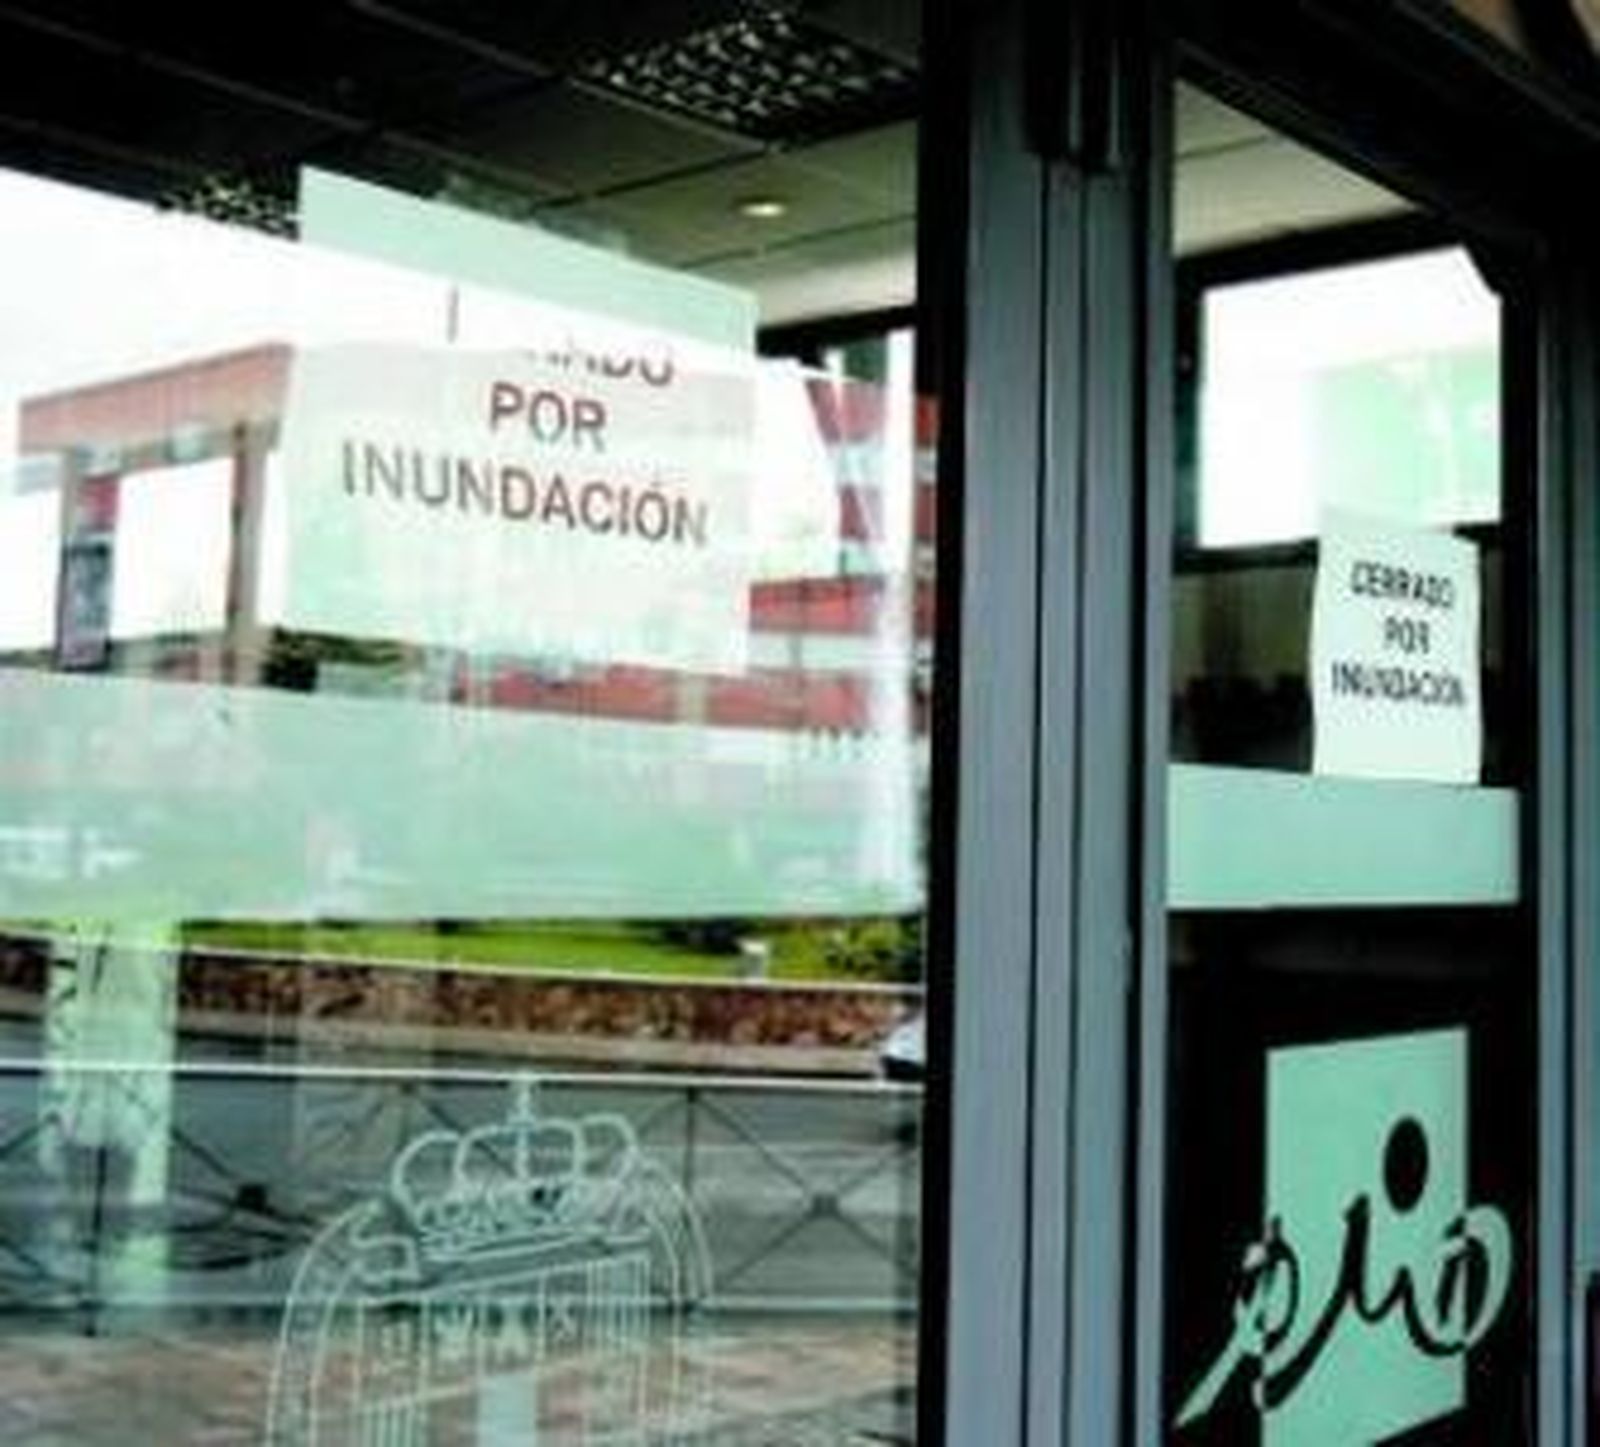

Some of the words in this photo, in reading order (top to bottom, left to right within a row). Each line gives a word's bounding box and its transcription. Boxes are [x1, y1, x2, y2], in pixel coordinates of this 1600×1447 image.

[490, 381, 606, 450] POR
[342, 441, 707, 546] INUNDACIÓN
[1384, 615, 1429, 654] POR
